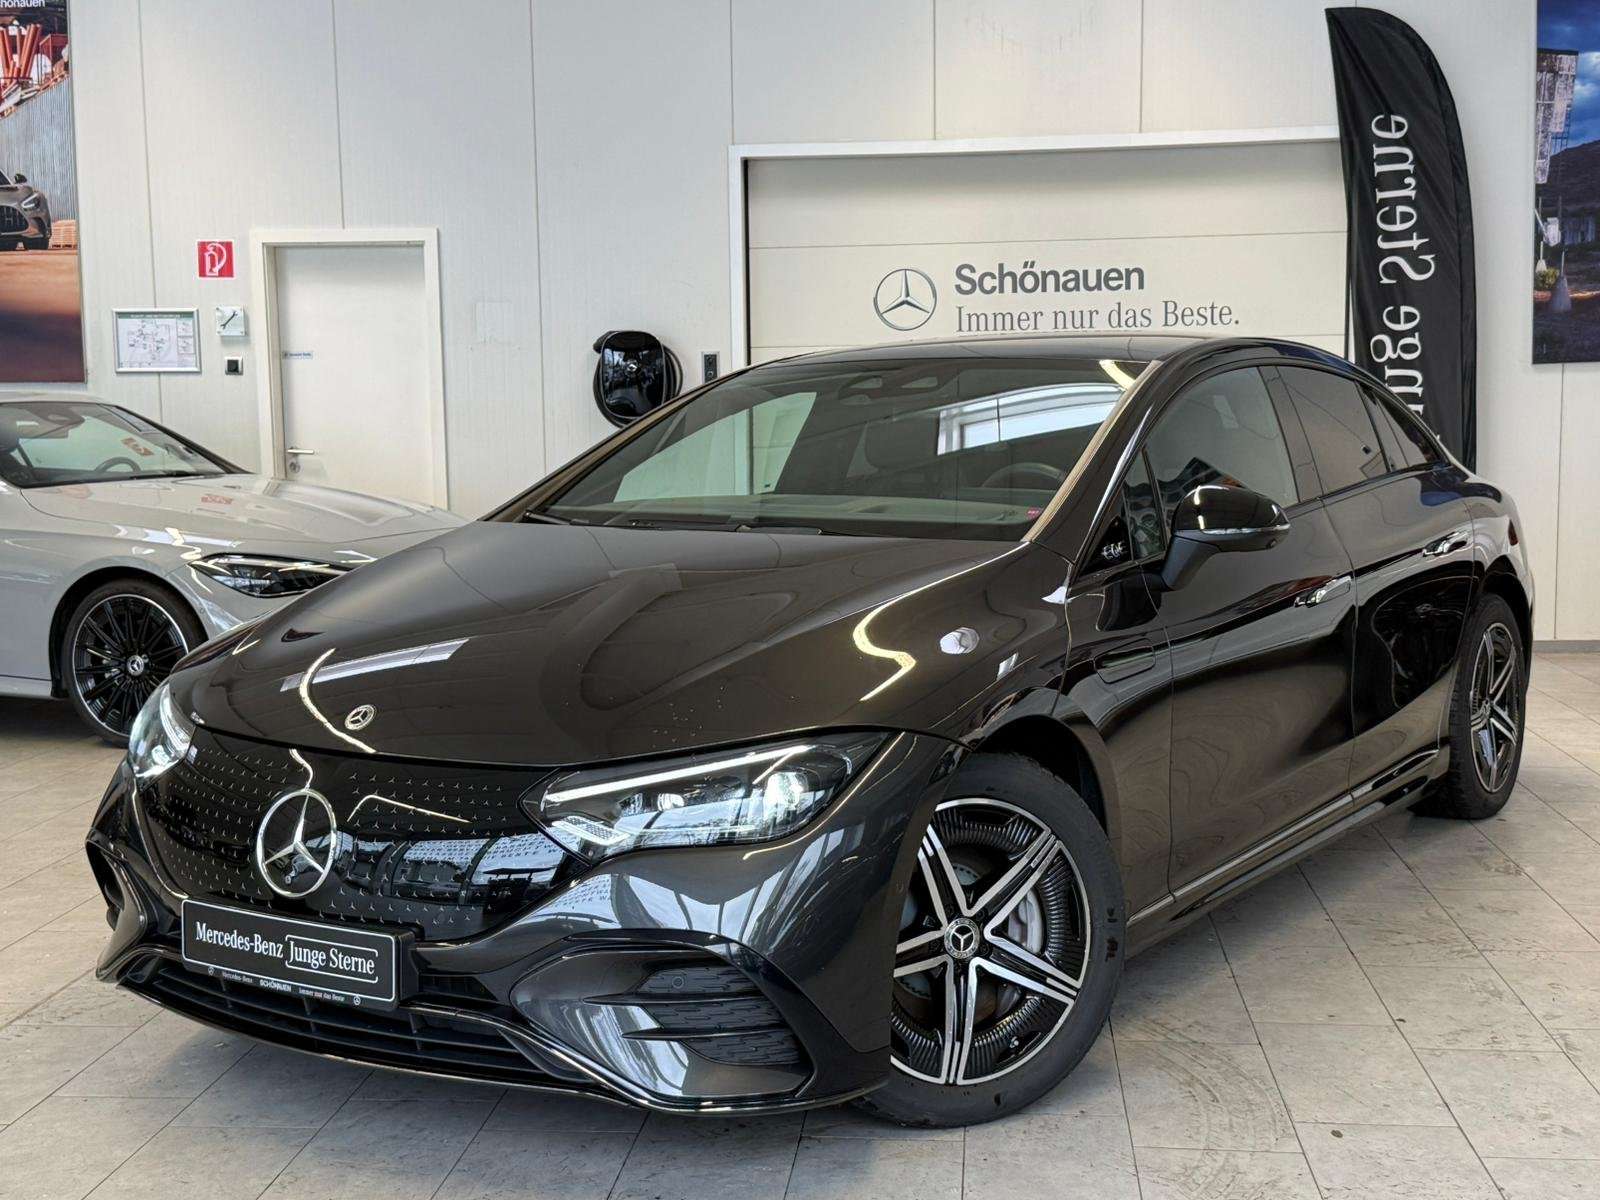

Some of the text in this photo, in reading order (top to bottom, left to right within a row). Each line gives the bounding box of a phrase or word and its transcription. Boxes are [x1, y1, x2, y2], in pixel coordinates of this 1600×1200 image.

[955, 260, 1145, 296] Schönauen
[956, 300, 1240, 332] Immer nur das Beste.
[195, 921, 375, 975] Mercedes-Benz Junge Sterne
